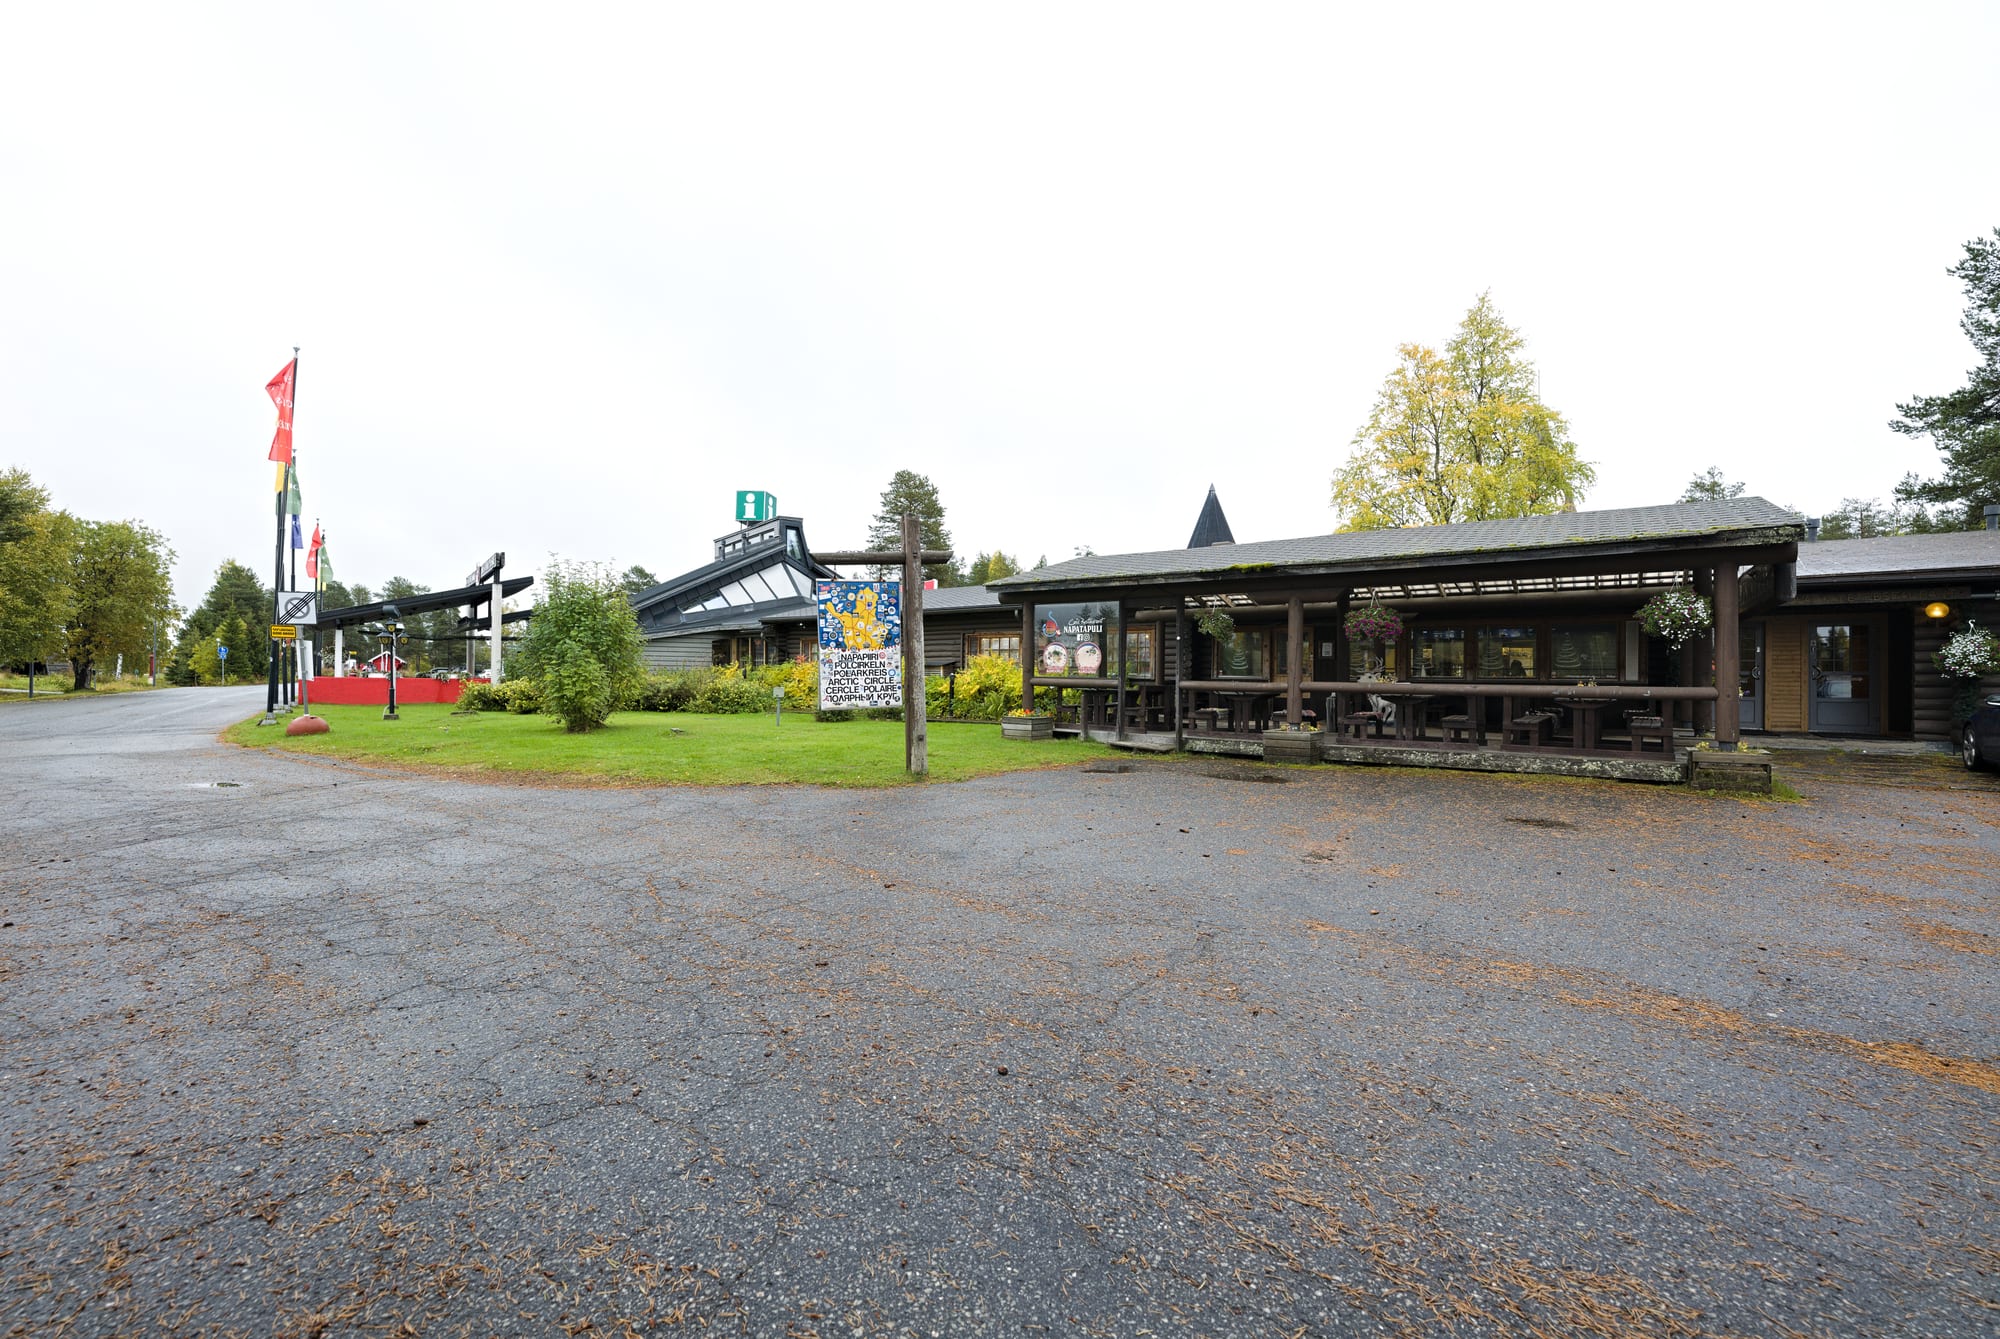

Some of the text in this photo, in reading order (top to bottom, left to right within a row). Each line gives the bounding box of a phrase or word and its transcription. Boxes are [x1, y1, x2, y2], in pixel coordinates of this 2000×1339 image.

[1063, 625, 1103, 633] NAPATAPULI
[840, 653, 879, 661] NAPAPIIRI
[834, 661, 886, 669] POLCIRKELN
[833, 669, 888, 677] POLARKREIS
[828, 676, 895, 686] ARCTIC CIRCLE
[825, 684, 897, 694] CERCLE POLAIRE
[876, 692, 897, 701] КРУГ
